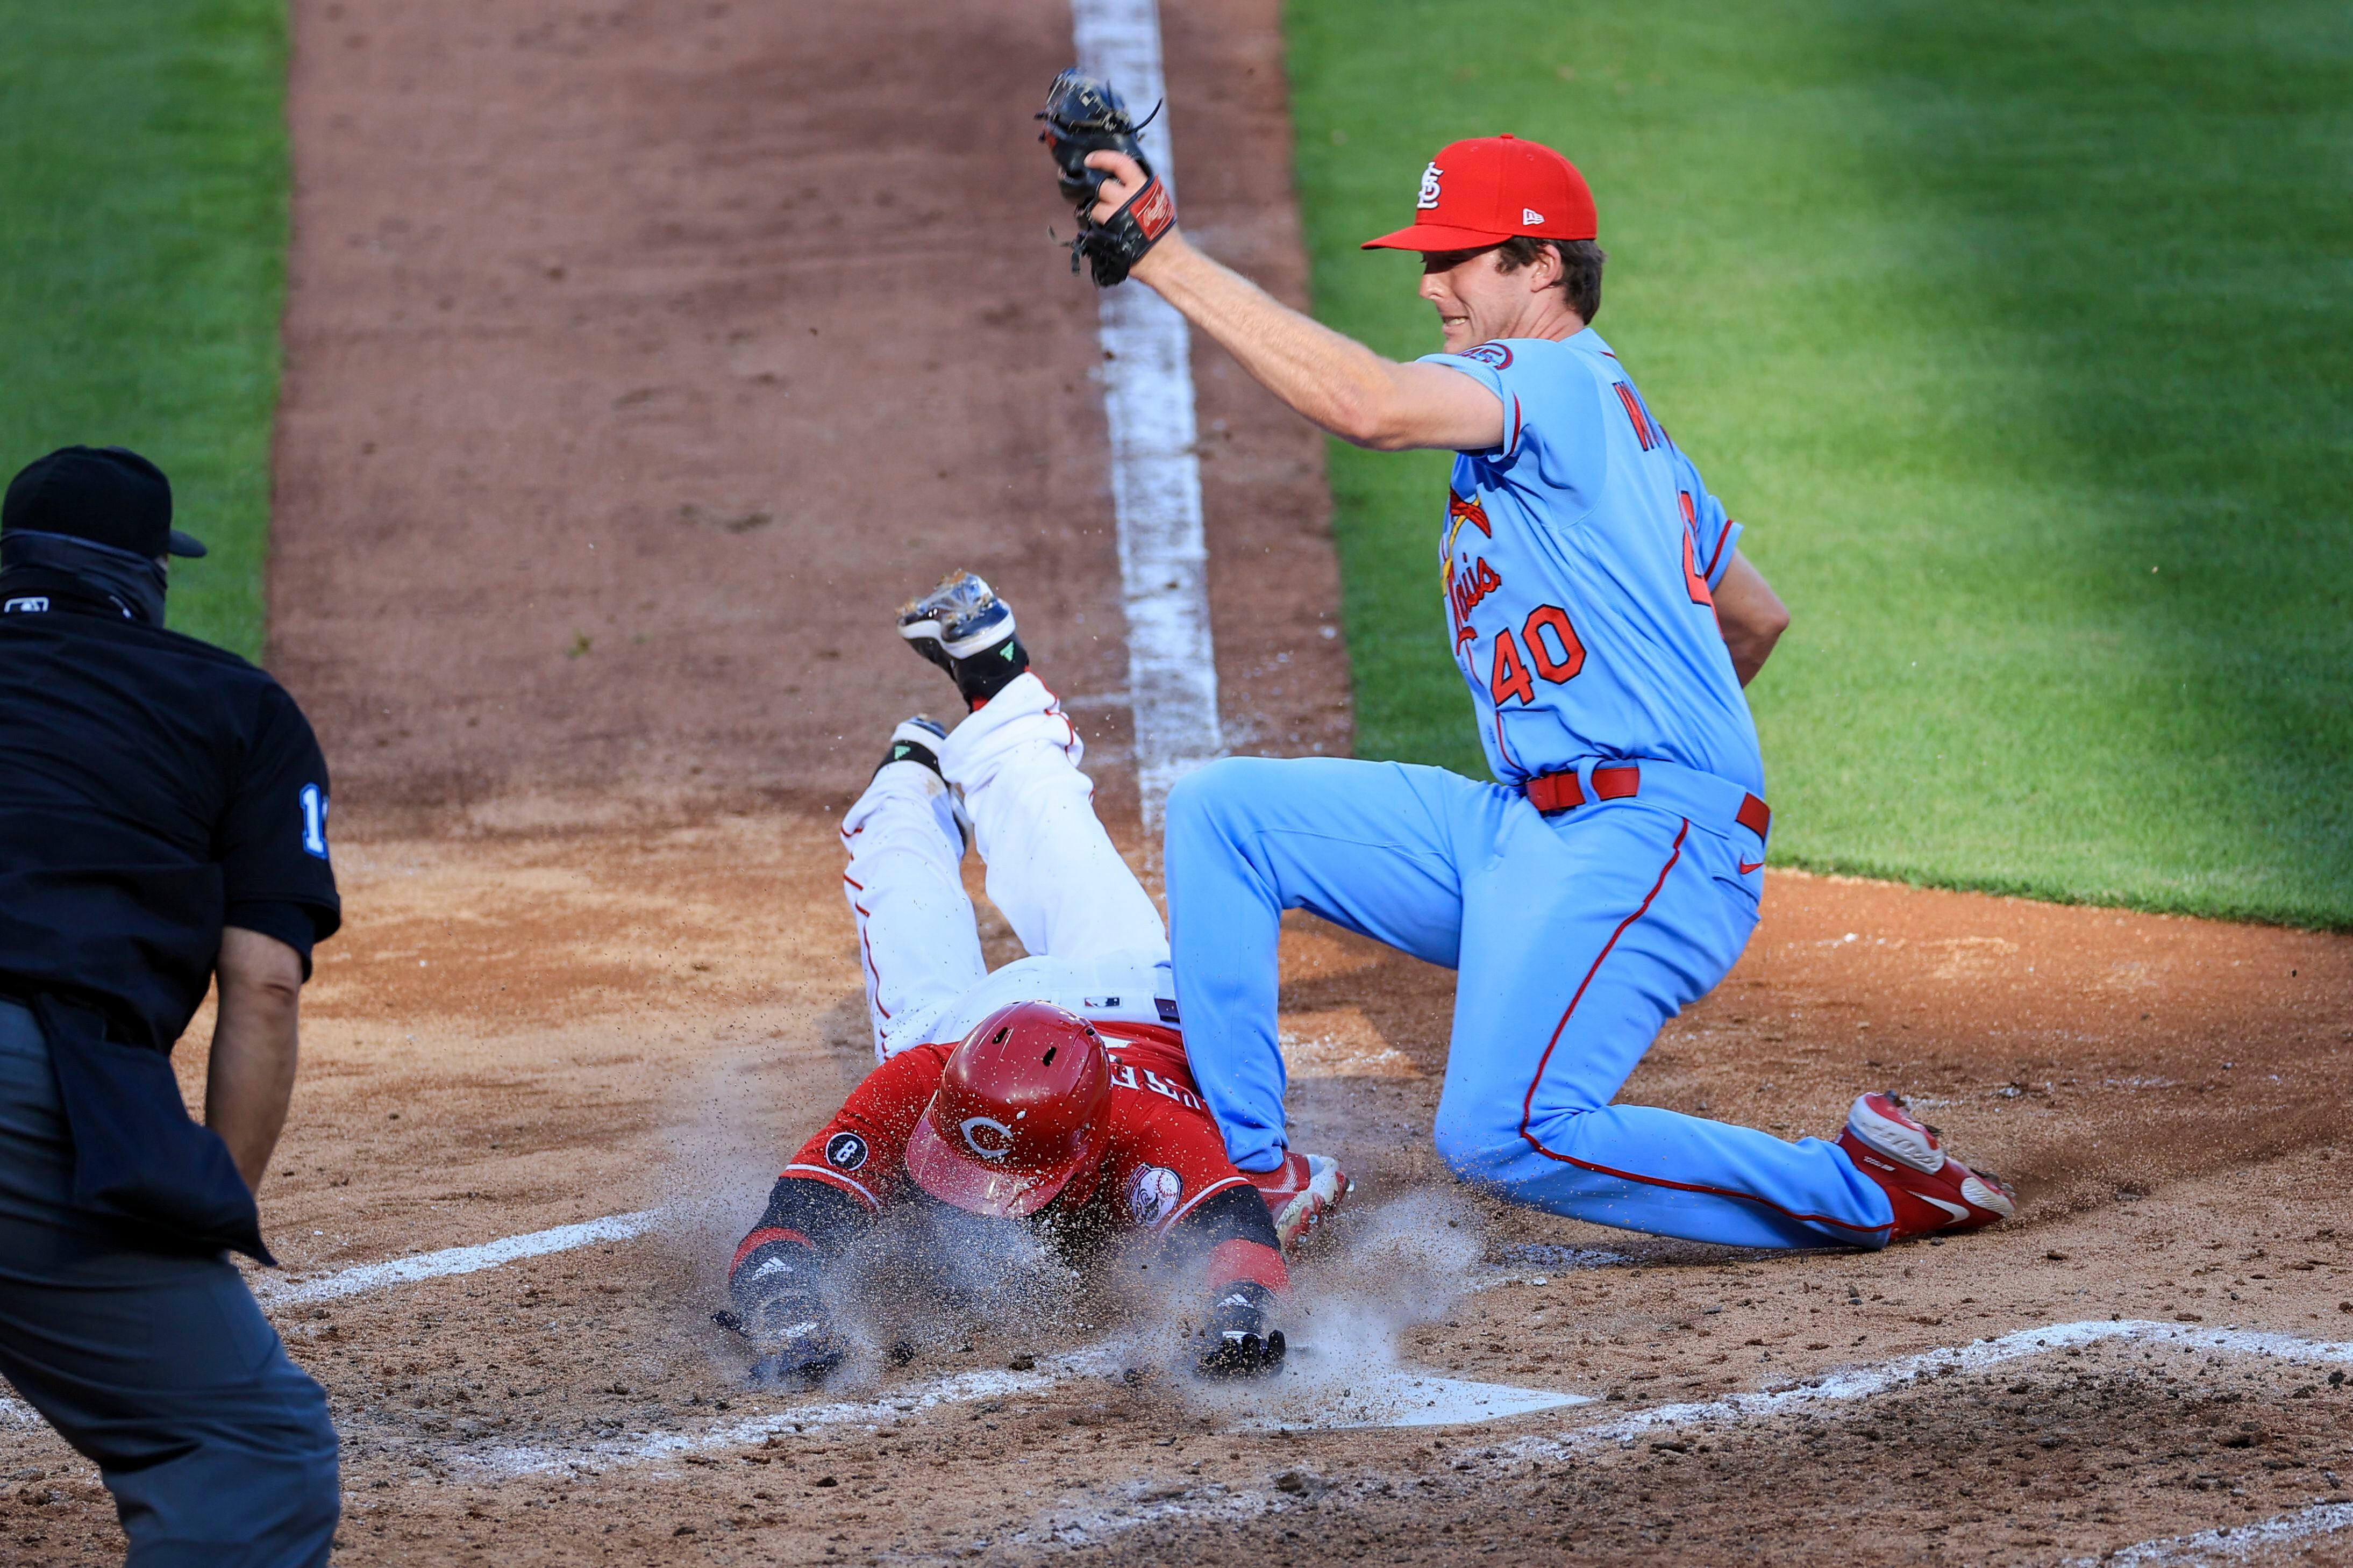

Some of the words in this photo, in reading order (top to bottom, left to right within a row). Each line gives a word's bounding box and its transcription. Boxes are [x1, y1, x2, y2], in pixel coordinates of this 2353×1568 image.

[1491, 603, 1587, 708] 40
[298, 782, 330, 860] 1
[836, 1140, 858, 1163] 8
[959, 1116, 1014, 1158] C
[752, 1264, 793, 1281] adidas
